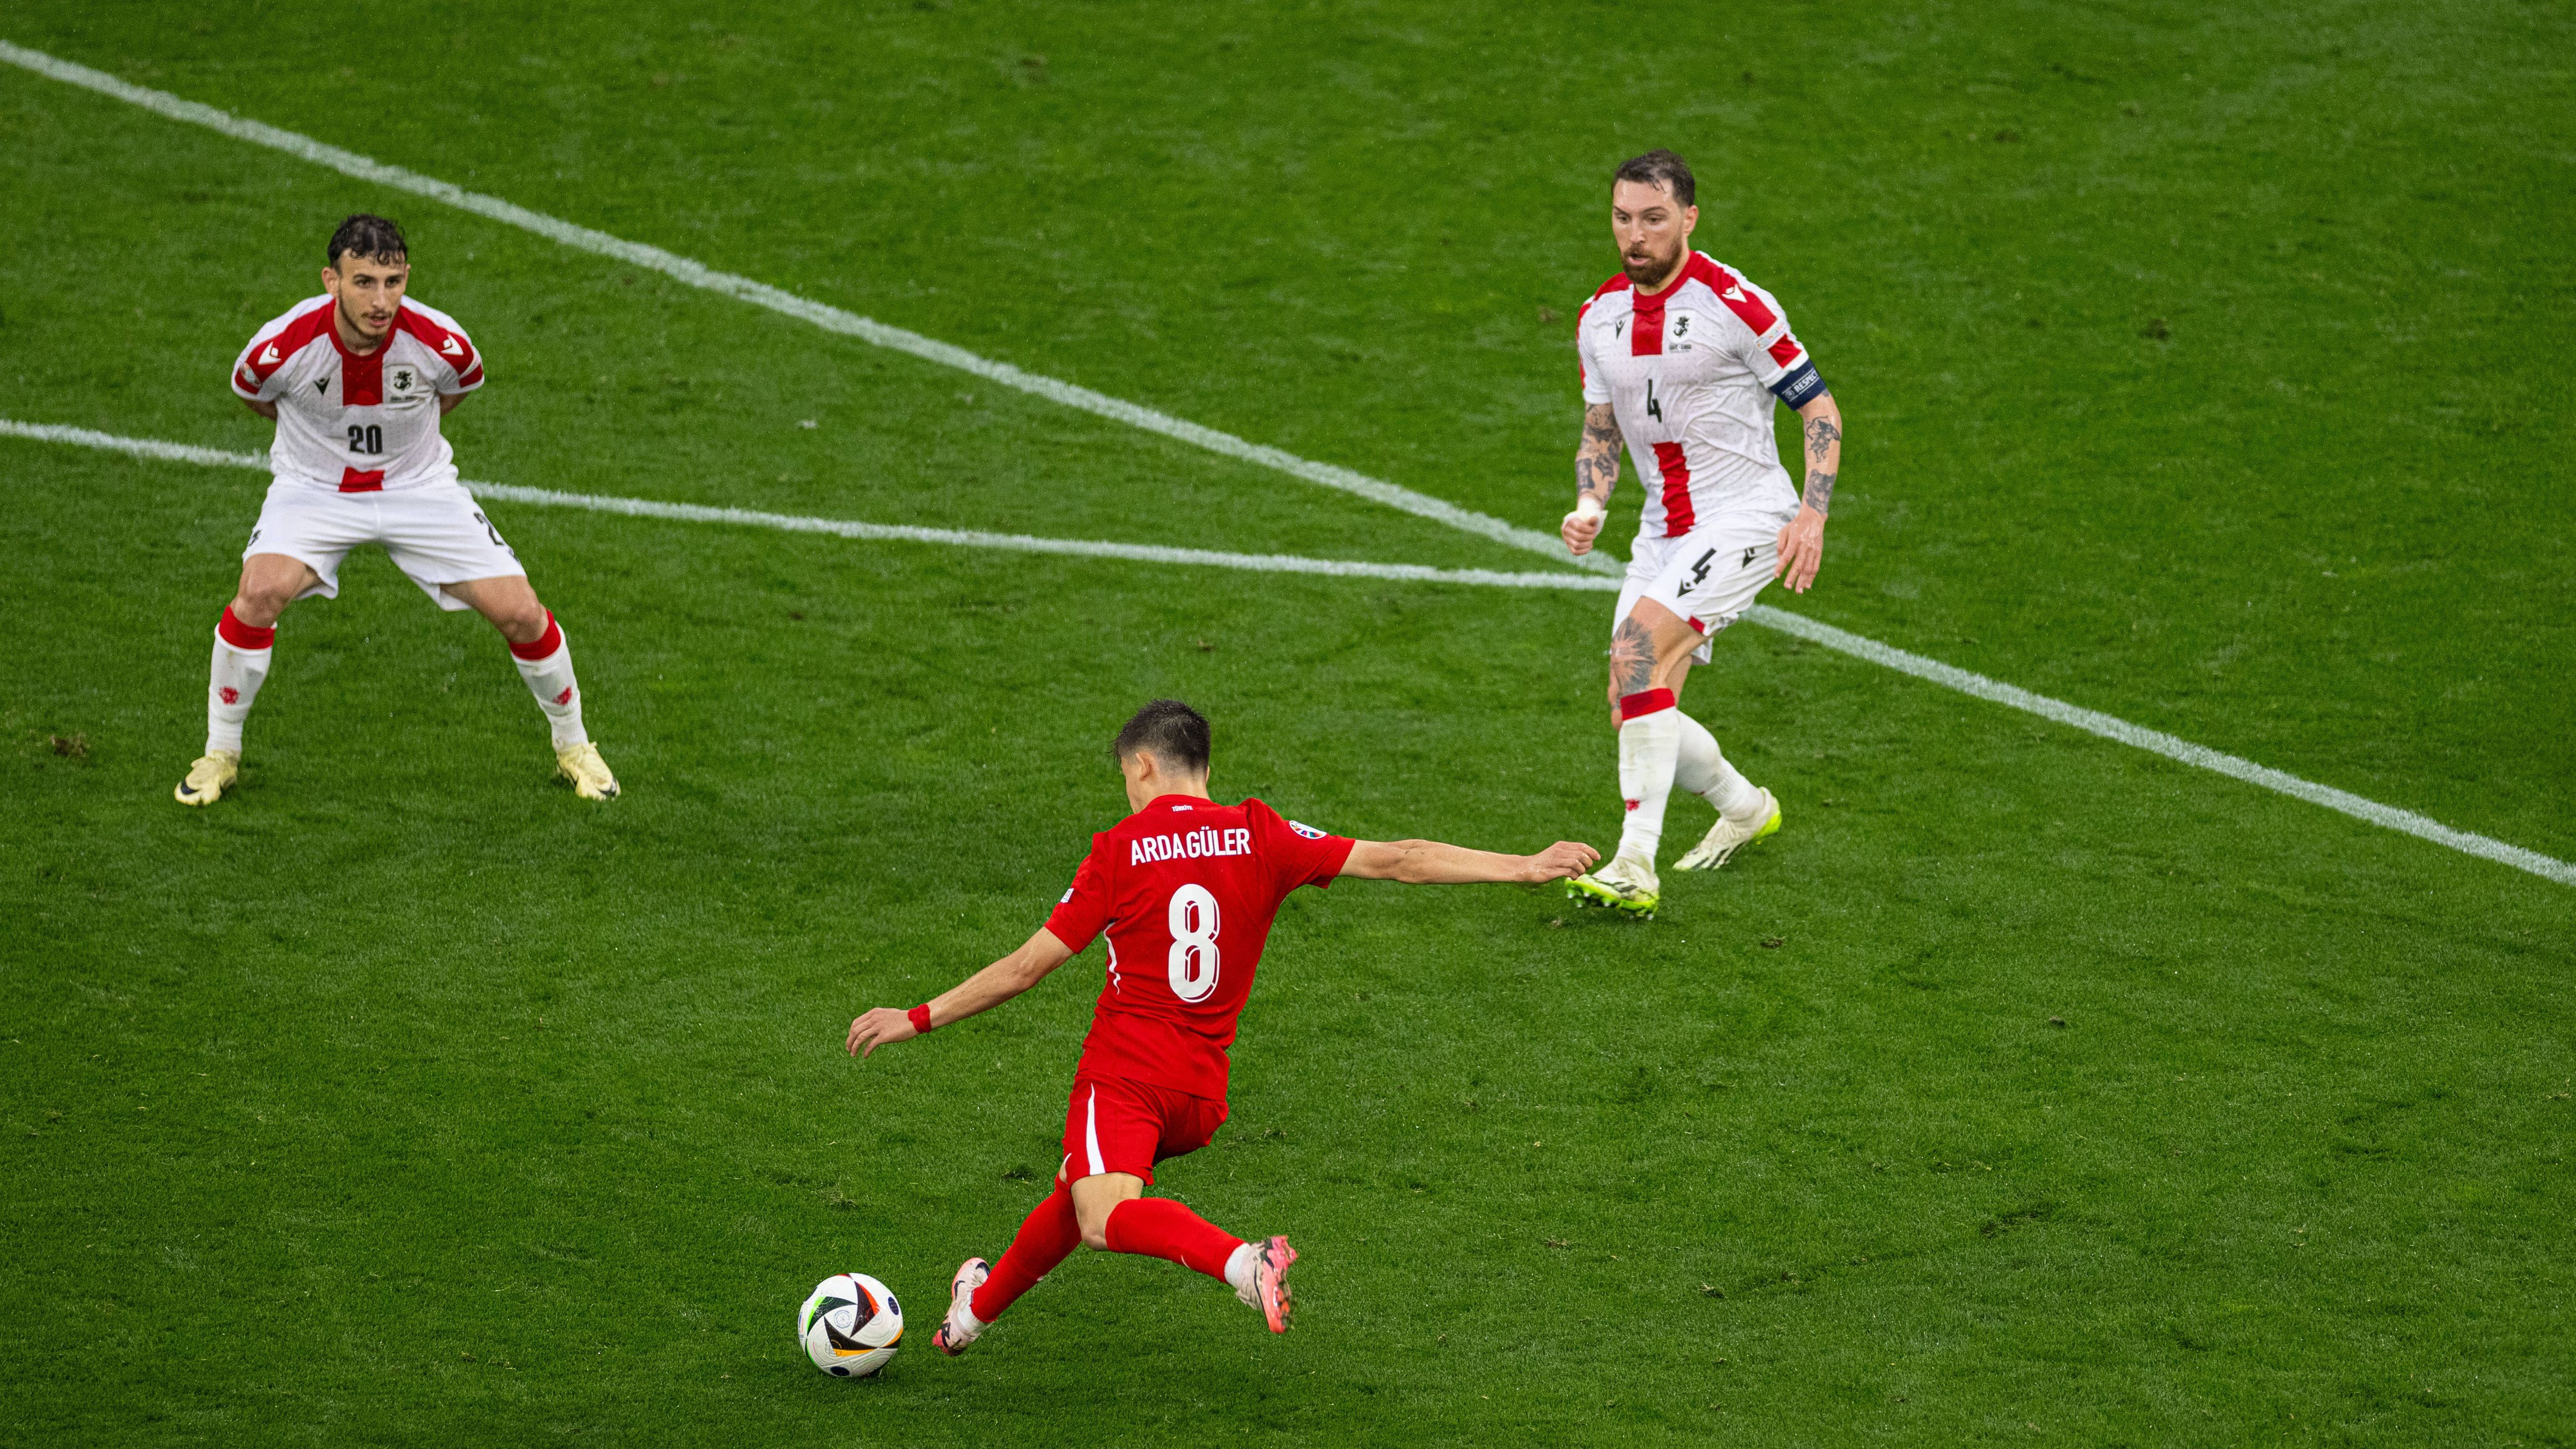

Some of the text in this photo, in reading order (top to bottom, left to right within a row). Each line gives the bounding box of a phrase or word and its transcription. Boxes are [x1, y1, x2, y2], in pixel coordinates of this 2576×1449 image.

[1647, 378, 1663, 423] 4
[348, 424, 383, 454] 20
[1690, 548, 1717, 585] 4
[1131, 826, 1251, 866] ARDA GÜLER
[1168, 883, 1221, 1003] 8
